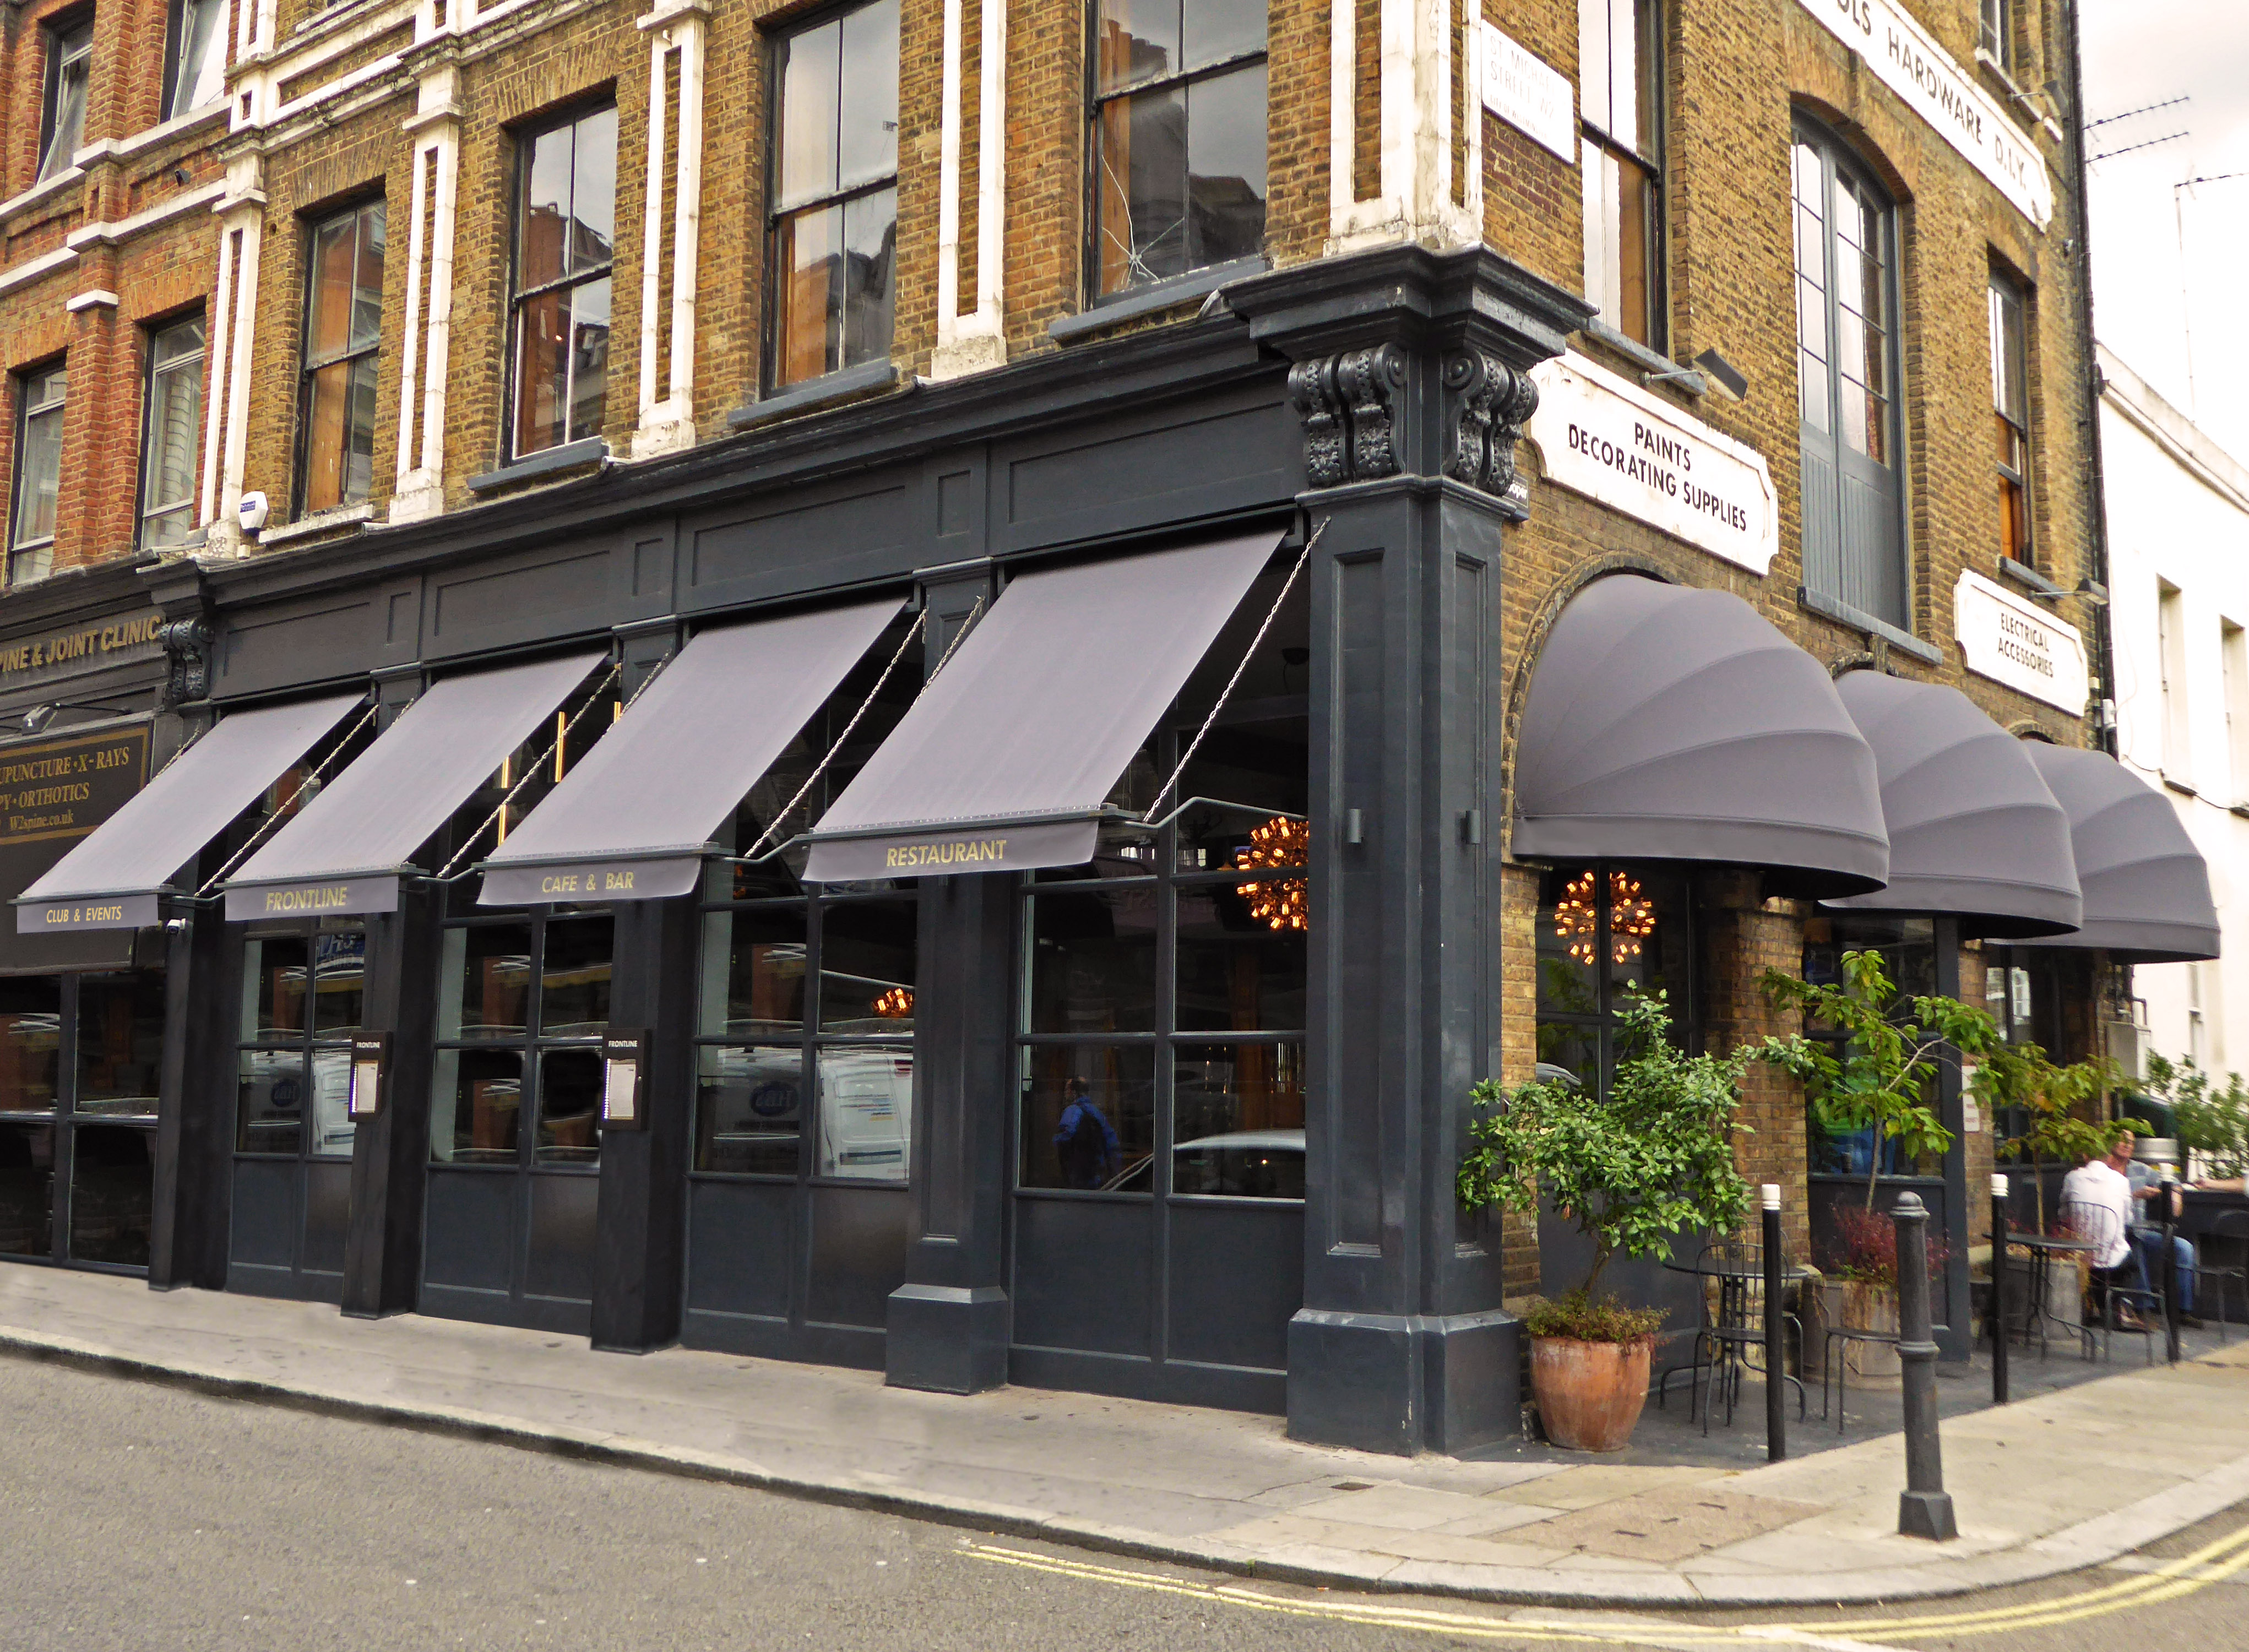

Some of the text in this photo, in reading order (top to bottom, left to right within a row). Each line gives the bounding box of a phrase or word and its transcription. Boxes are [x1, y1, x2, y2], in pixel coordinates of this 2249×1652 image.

[1491, 60, 1532, 104] STREET
[1888, 26, 1982, 146] HARDWARE
[1634, 422, 1691, 472] PAINTS
[1568, 423, 1747, 532] DECORATING SUPPLIES
[31, 643, 42, 666] &
[46, 629, 99, 664] JOINT
[101, 615, 161, 651] CLINIC
[2001, 612, 2050, 653] ELECTRICAL
[1998, 637, 2054, 678] ACCESSORIES
[19, 781, 90, 809] ORTHOTICS
[886, 839, 1007, 867] RESTAURANT
[265, 886, 347, 911] FRONTLINE
[541, 871, 635, 893] CAFE & BAR
[46, 905, 122, 923] CLUB & EVENTS
[608, 1040, 638, 1048] FRONTLINE
